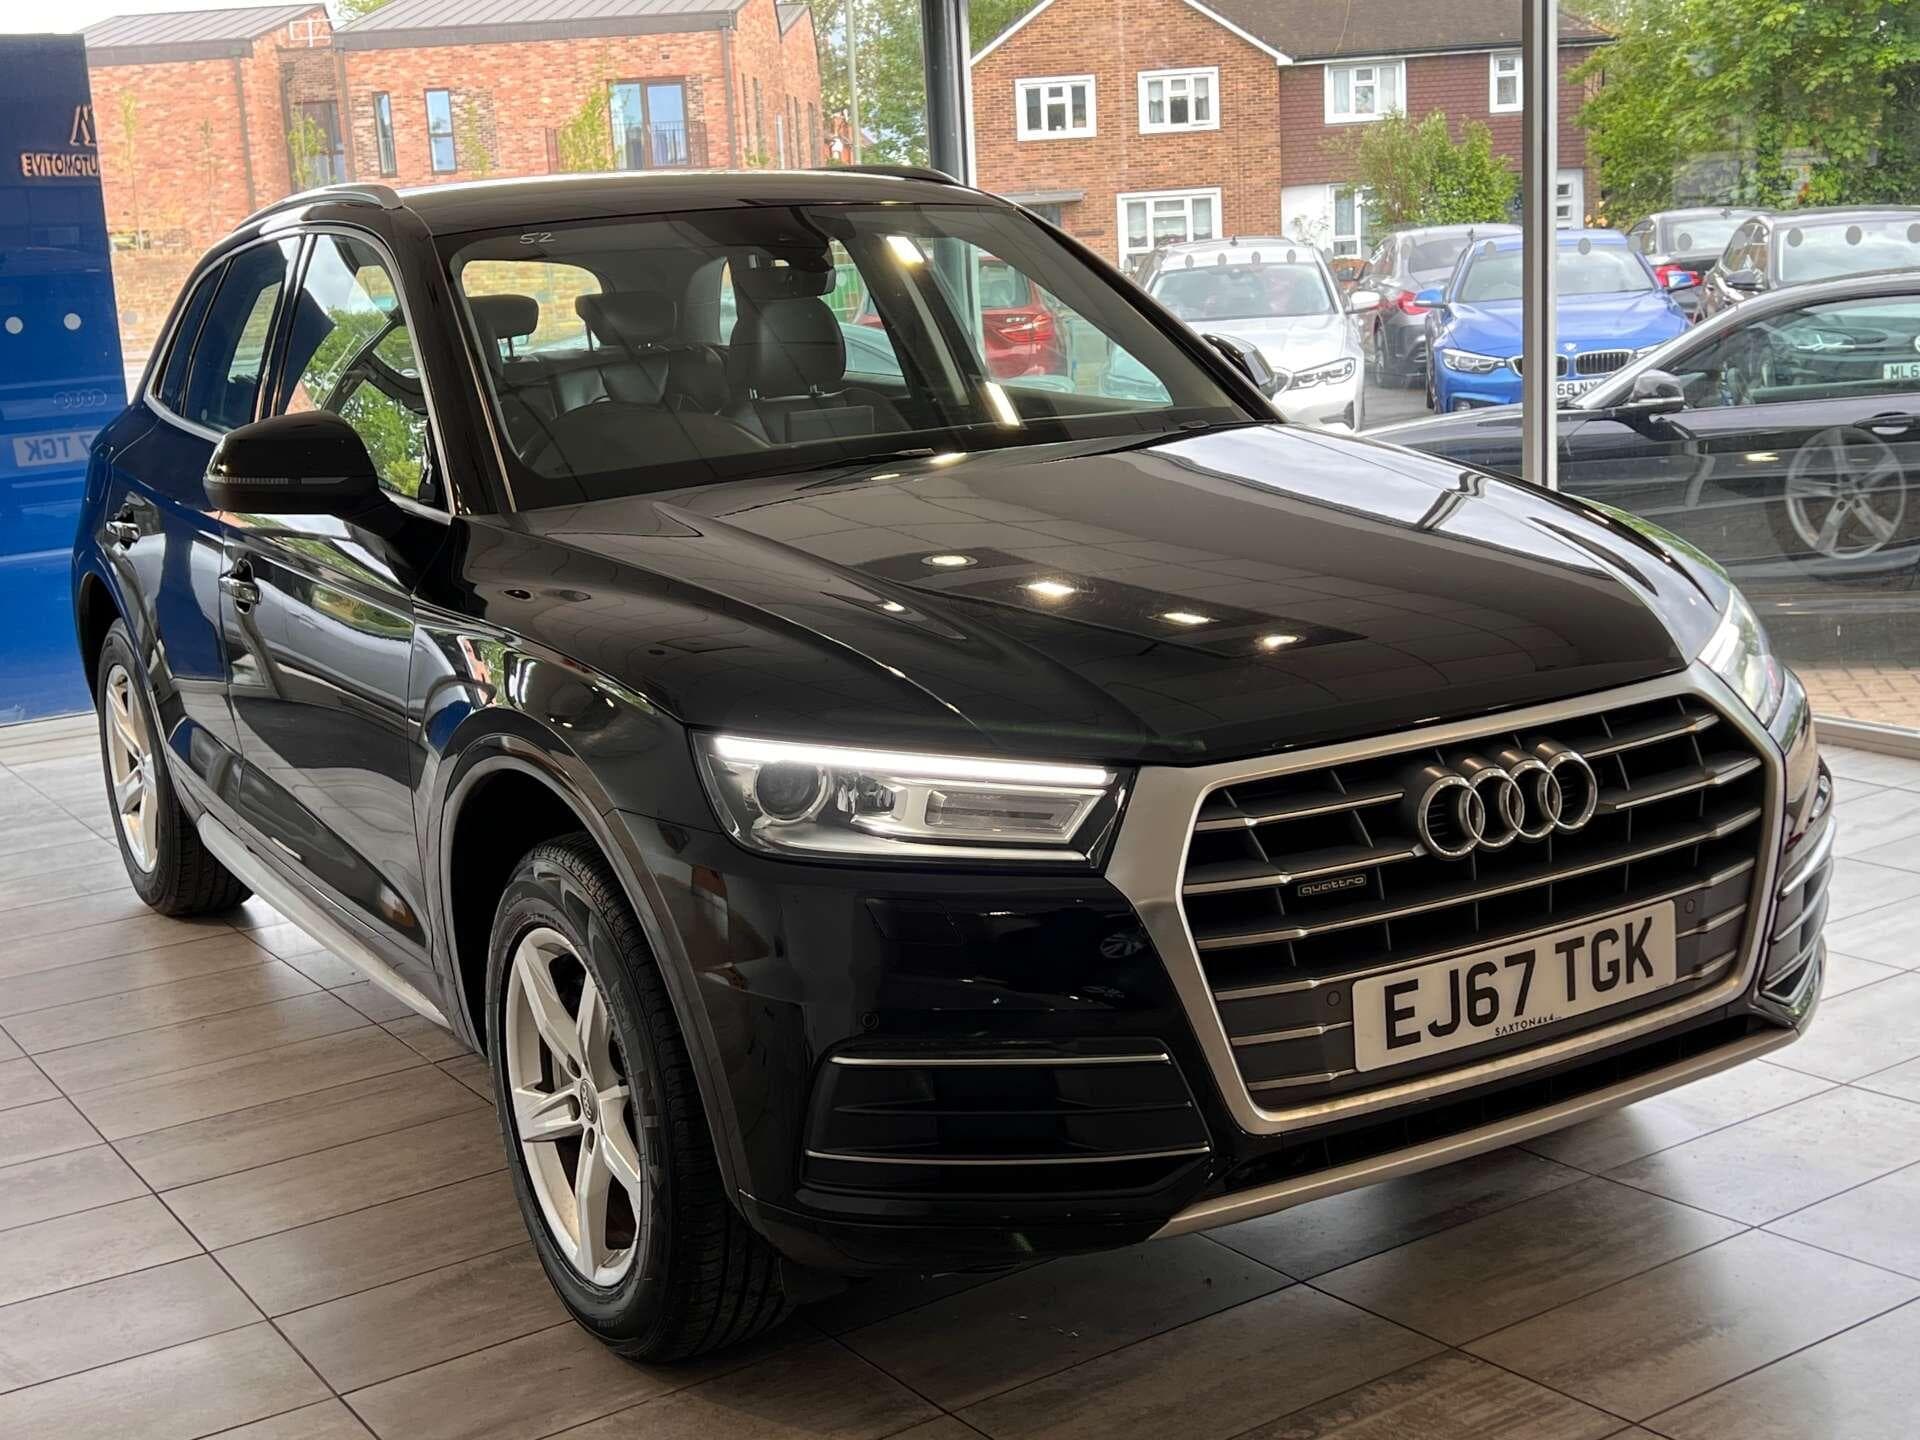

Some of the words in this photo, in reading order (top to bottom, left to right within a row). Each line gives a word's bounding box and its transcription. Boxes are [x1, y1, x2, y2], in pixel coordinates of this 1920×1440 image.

[1301, 876, 1364, 895] quattro
[1384, 949, 1536, 1051] EJ67
[1555, 916, 1654, 1002] TGK
